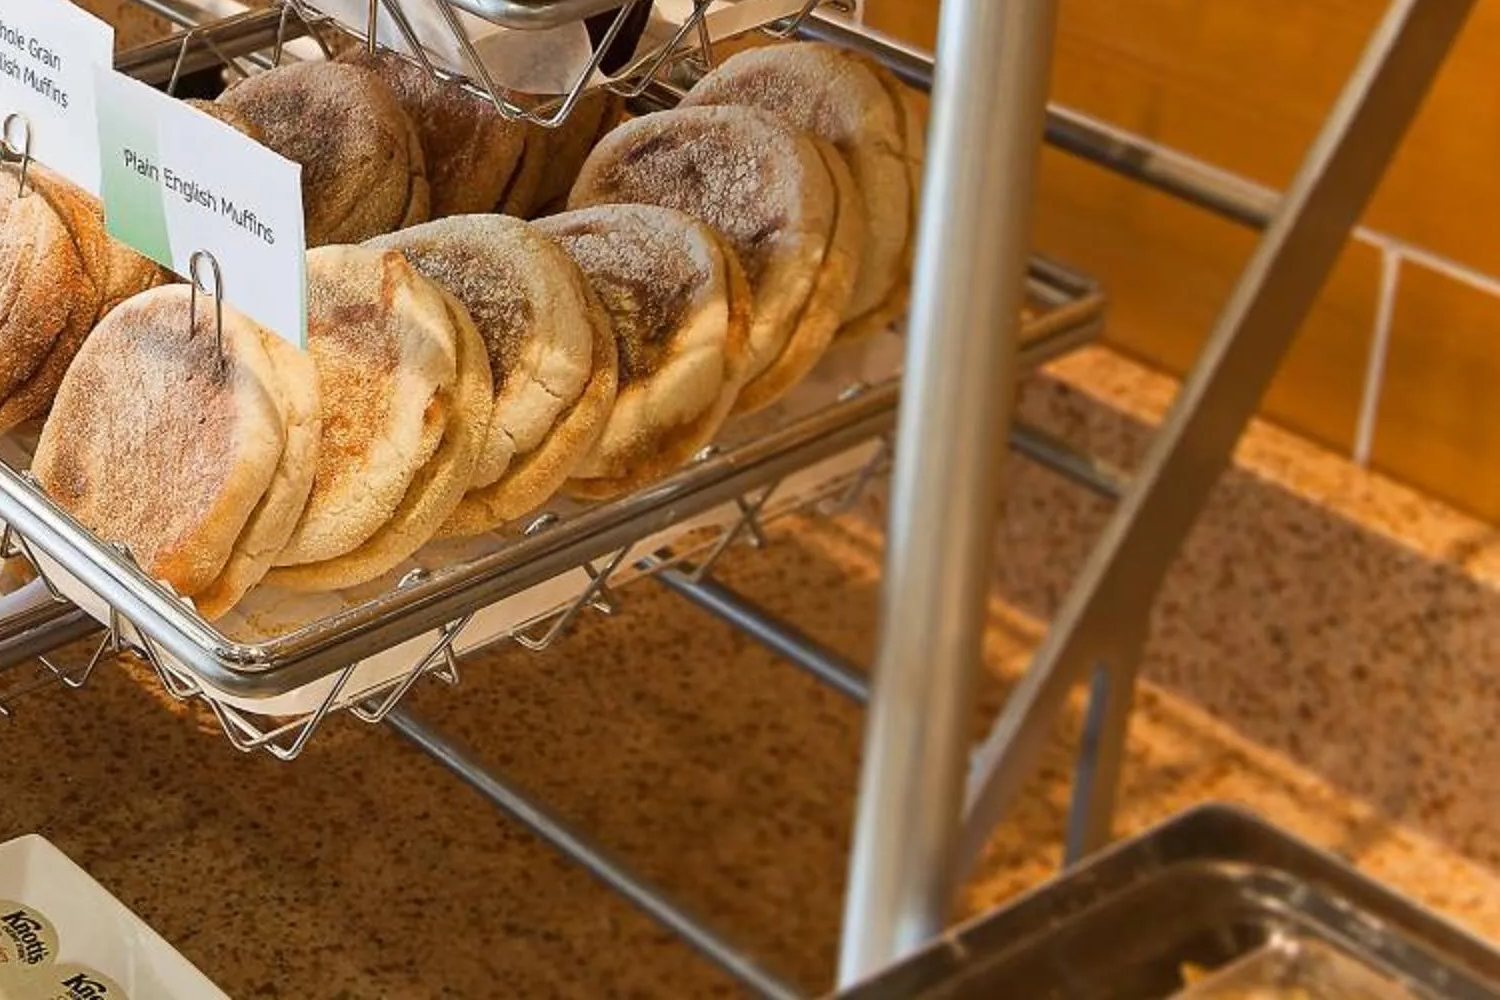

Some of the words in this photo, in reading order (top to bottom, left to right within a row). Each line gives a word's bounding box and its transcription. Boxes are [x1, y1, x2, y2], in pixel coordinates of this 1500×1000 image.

[29, 38, 61, 71] Grain
[23, 66, 69, 109] Muffins
[123, 149, 159, 182] Plain
[163, 167, 217, 213] English
[221, 197, 275, 245] Muffins
